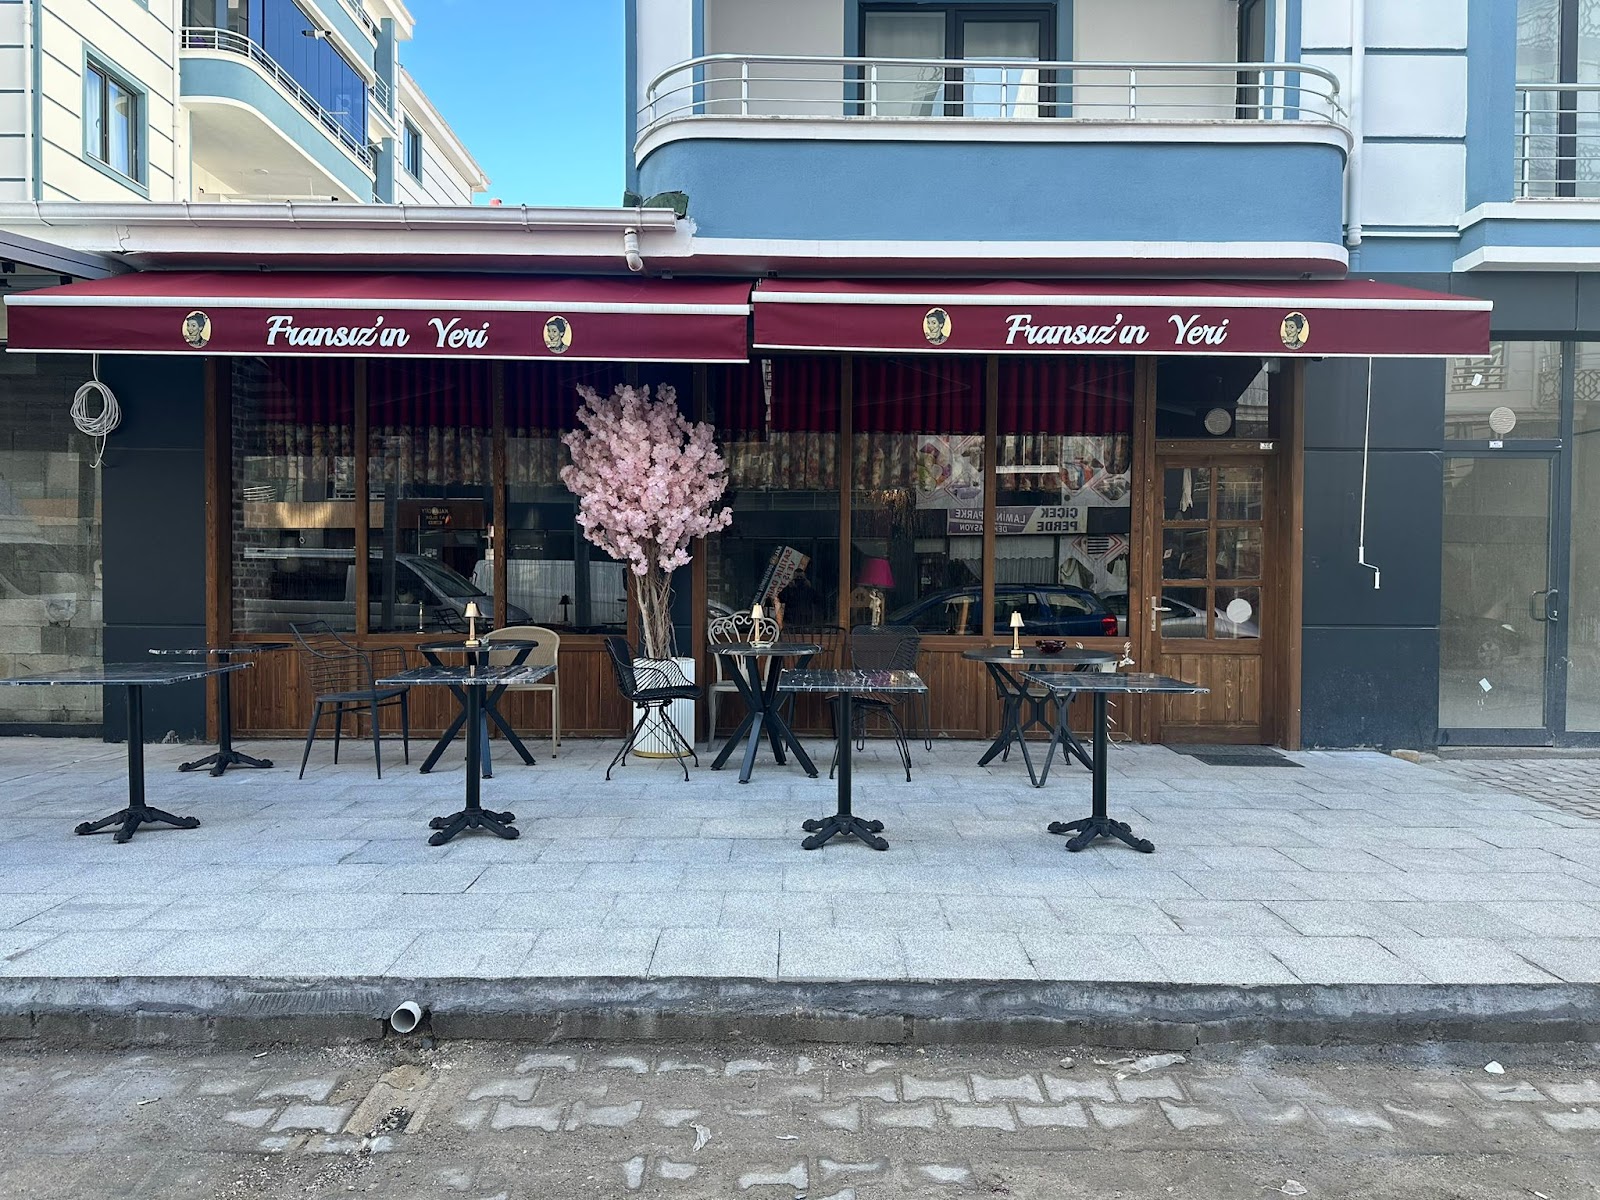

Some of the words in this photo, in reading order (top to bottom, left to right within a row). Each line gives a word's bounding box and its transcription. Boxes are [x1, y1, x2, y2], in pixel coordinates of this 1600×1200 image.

[266, 315, 411, 347] Fransız'ın
[428, 317, 490, 349] Yeri
[1005, 313, 1150, 345] Fransız'ın
[1168, 314, 1230, 345] Yeri
